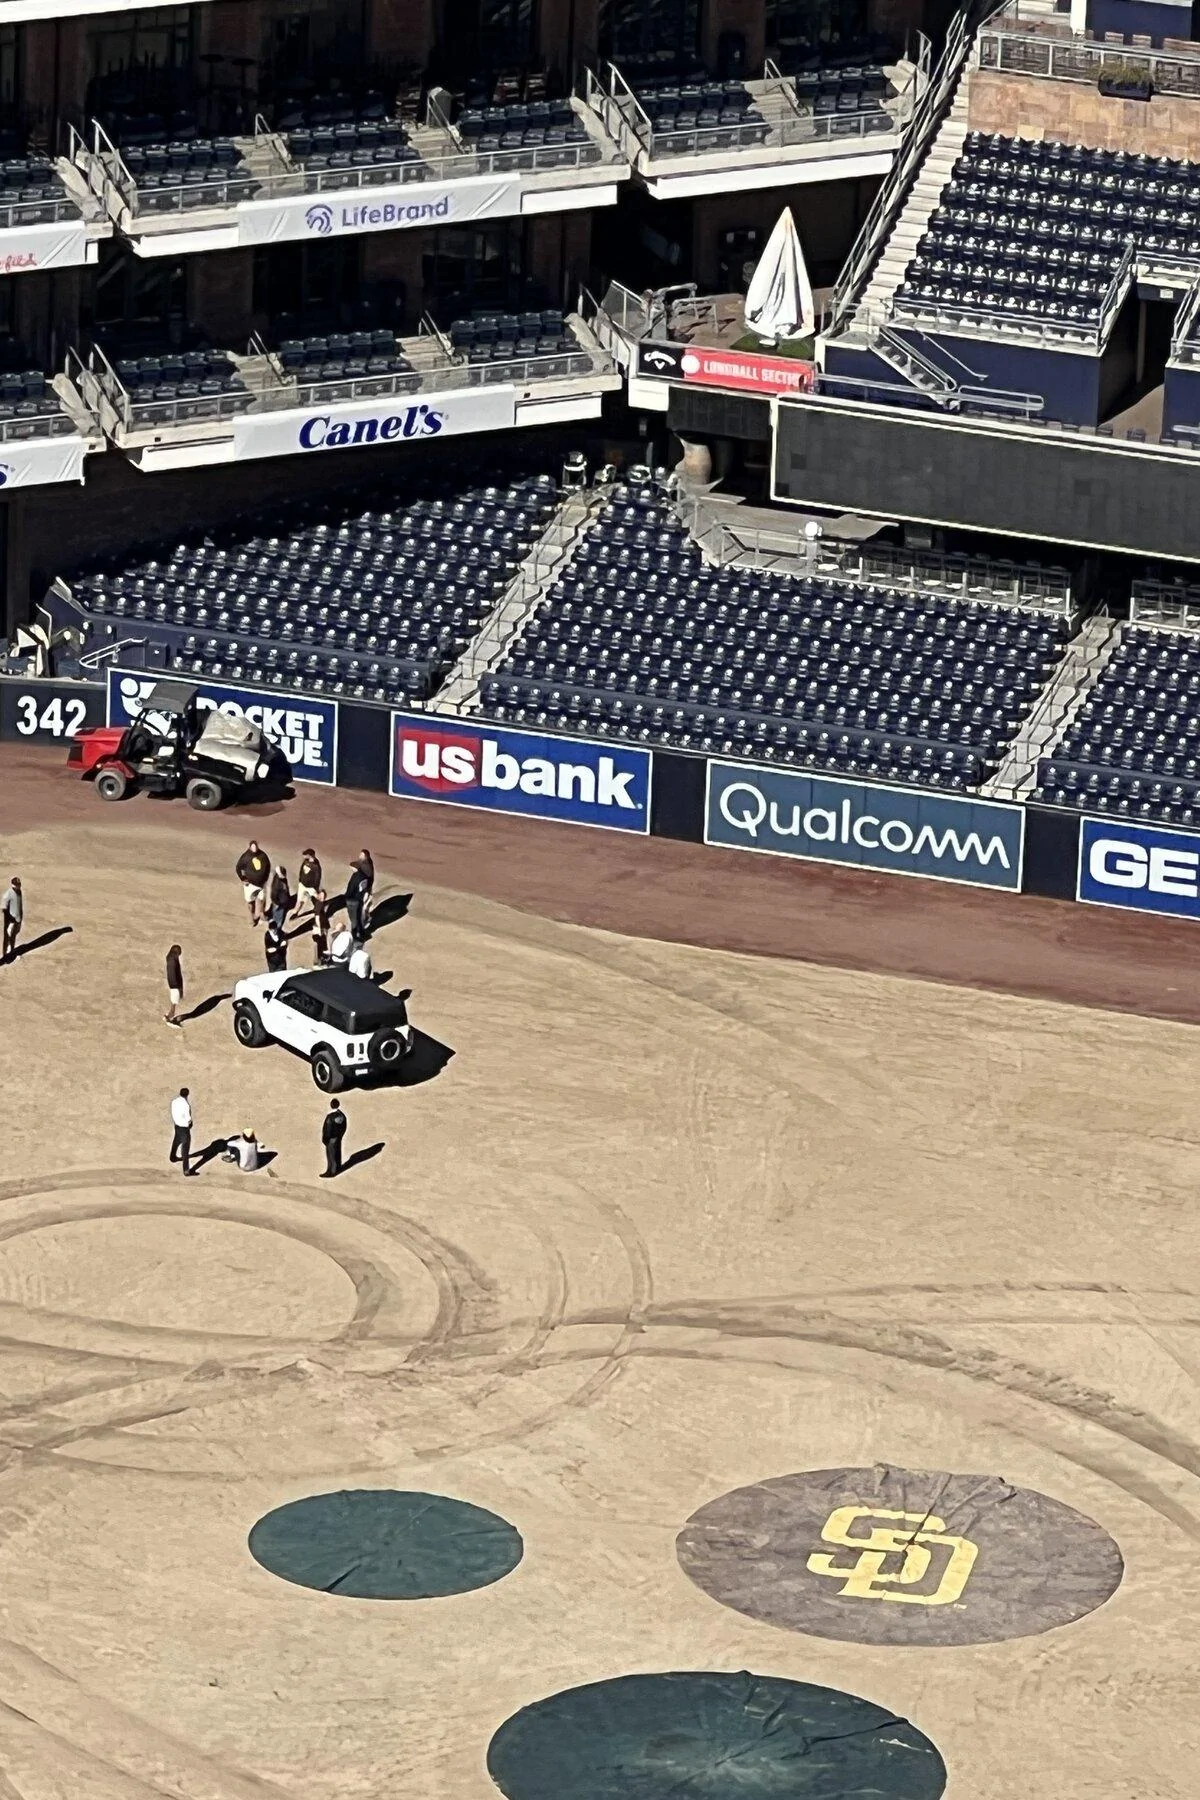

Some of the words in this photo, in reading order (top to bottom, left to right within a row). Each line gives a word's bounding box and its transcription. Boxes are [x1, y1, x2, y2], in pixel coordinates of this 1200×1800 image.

[341, 196, 449, 228] LifeBrand
[298, 404, 445, 450] Canel's
[15, 695, 88, 736] 342
[719, 782, 1011, 869] Qualcomm
